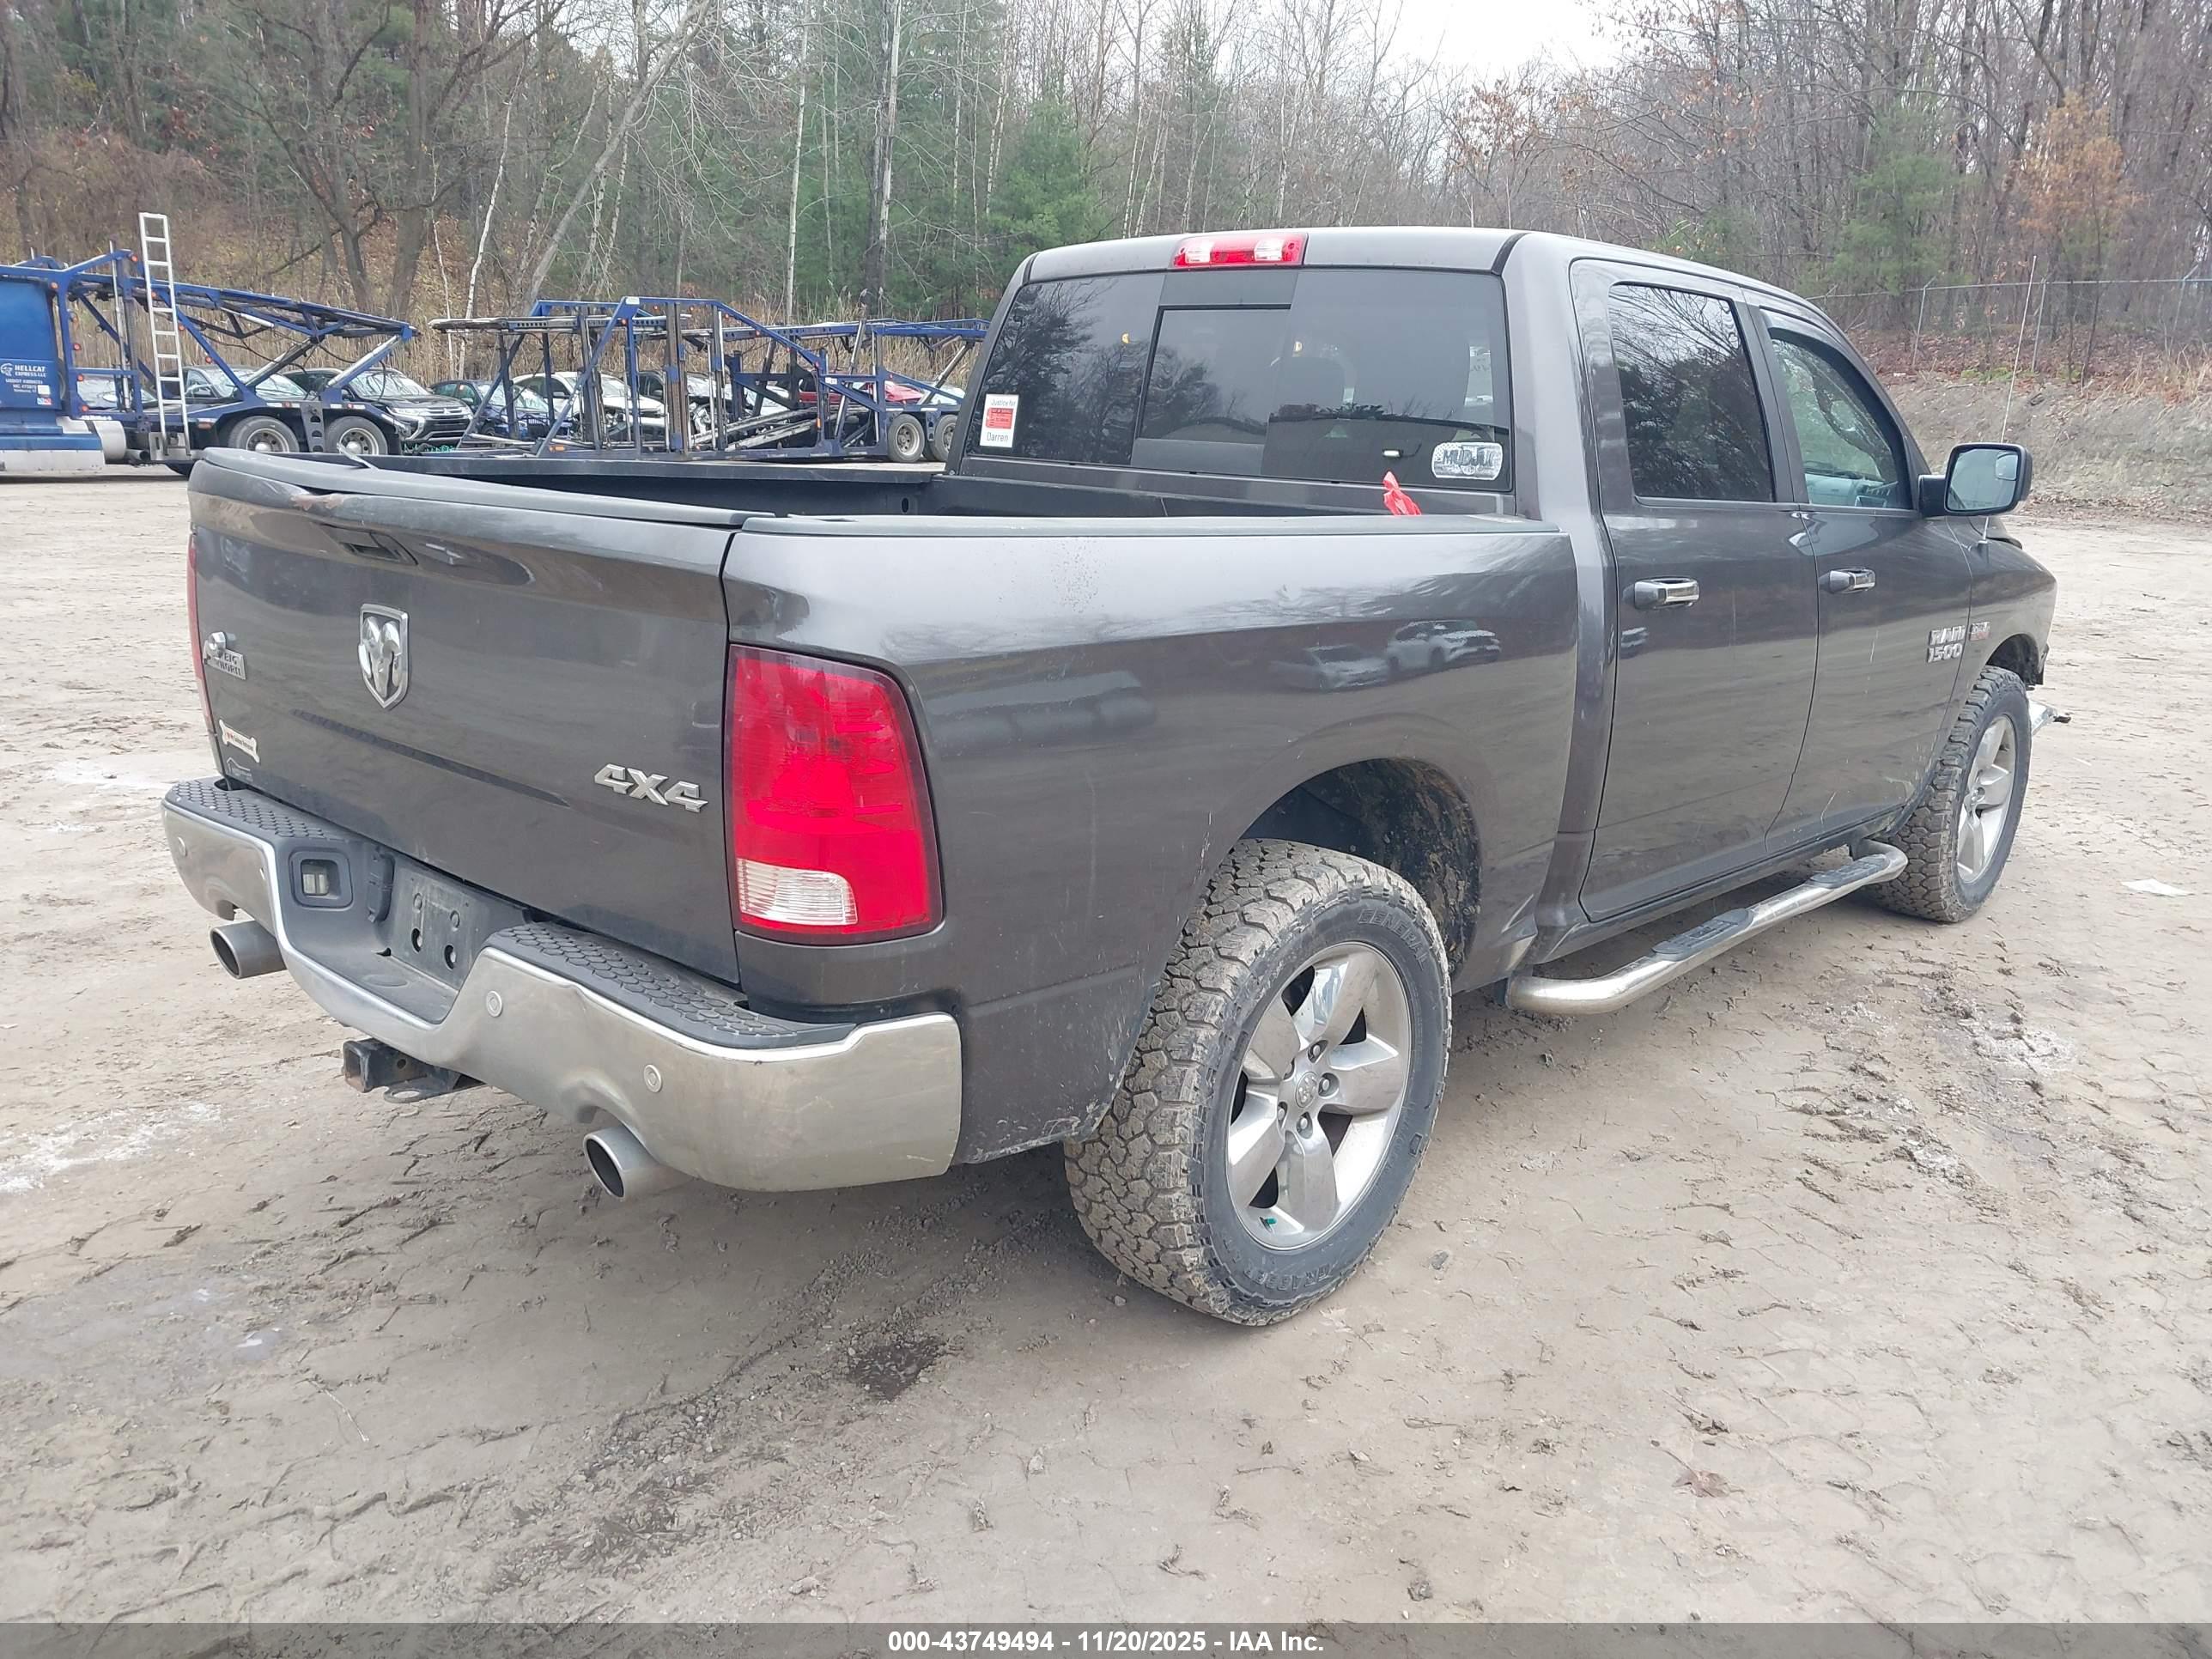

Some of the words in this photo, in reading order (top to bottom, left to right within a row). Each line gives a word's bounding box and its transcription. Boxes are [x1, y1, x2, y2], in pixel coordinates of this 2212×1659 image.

[986, 431, 1009, 443] Darren
[1929, 625, 1966, 646] RAM
[224, 652, 238, 665] BIG
[1926, 642, 1963, 663] 1500
[1357, 908, 1430, 972] GENERAL
